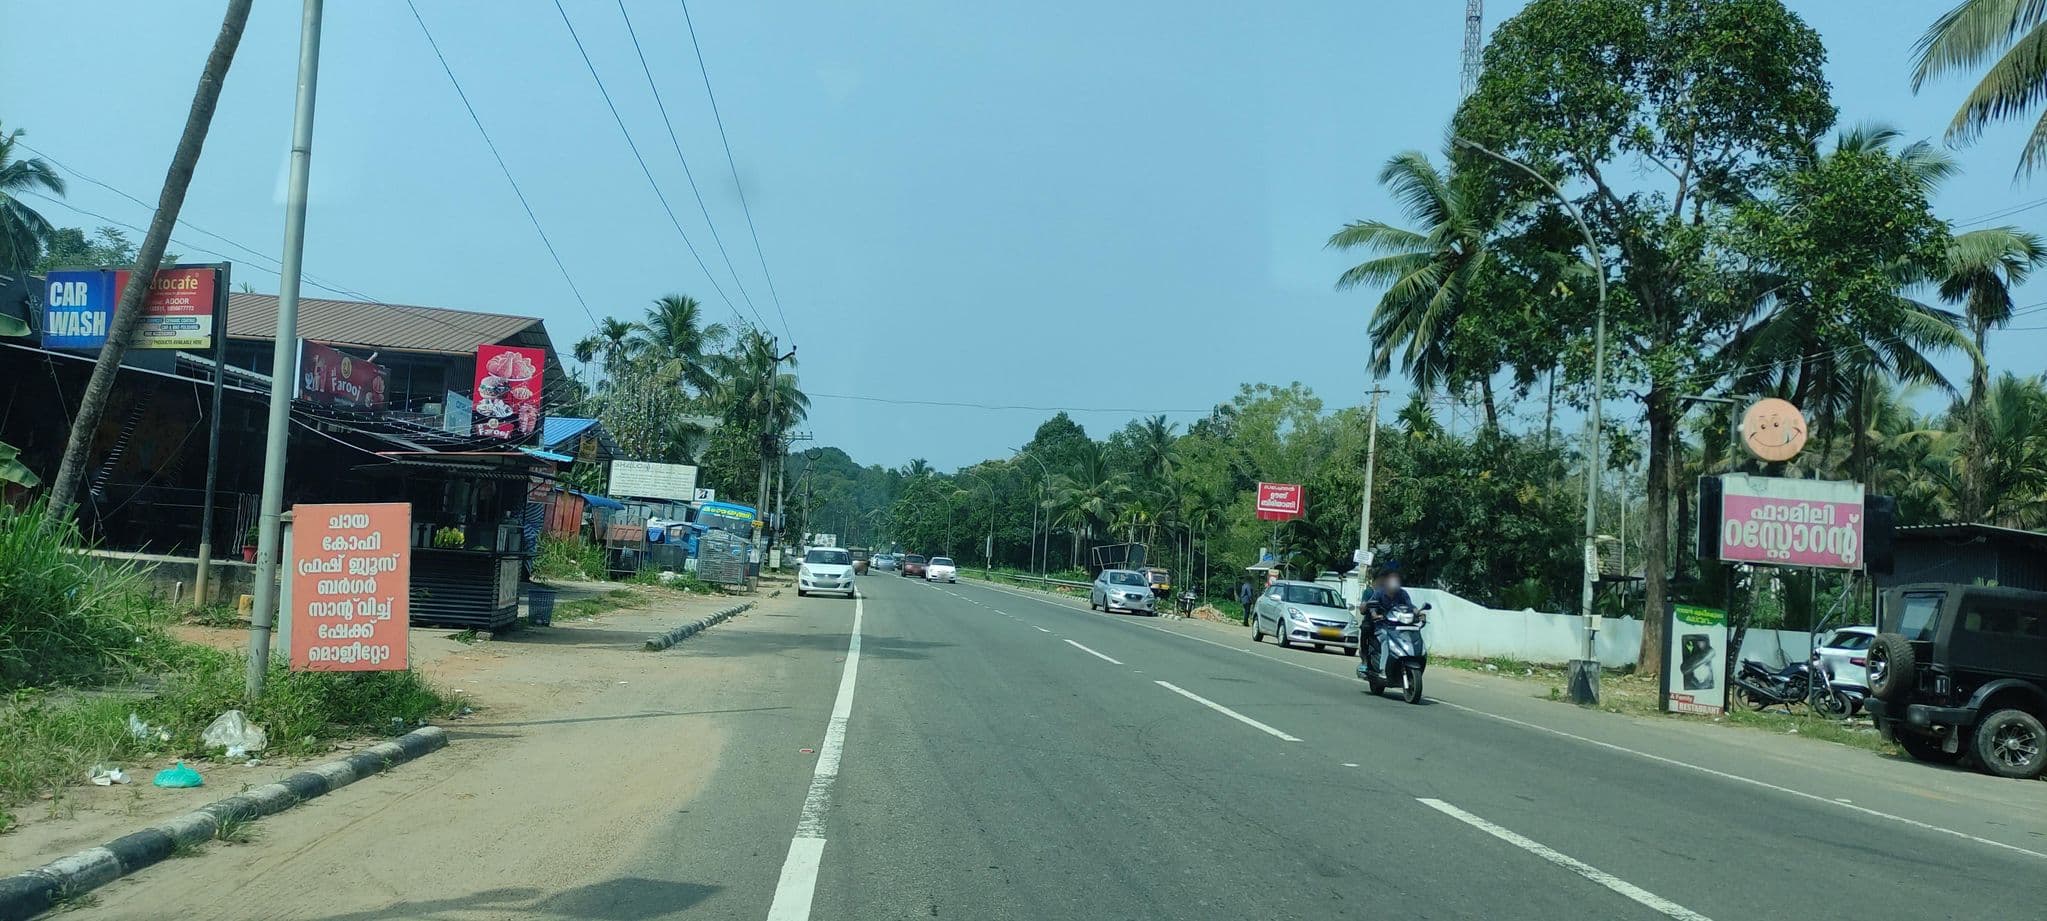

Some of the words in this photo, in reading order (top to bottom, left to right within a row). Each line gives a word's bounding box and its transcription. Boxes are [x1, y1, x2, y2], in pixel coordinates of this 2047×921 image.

[149, 275, 199, 290] utocafe
[50, 282, 87, 306] CAR
[165, 297, 190, 305] ADOOR
[49, 311, 106, 336] WASH
[331, 376, 362, 401] Farooj
[329, 514, 370, 529] ചായ
[1751, 503, 1836, 526] ഫാമിലി
[322, 531, 381, 551] കോഫി
[299, 554, 345, 576] ഫ്രഷ്
[317, 577, 377, 595] ബർഗർ
[318, 619, 377, 639] ഷേക്ക്
